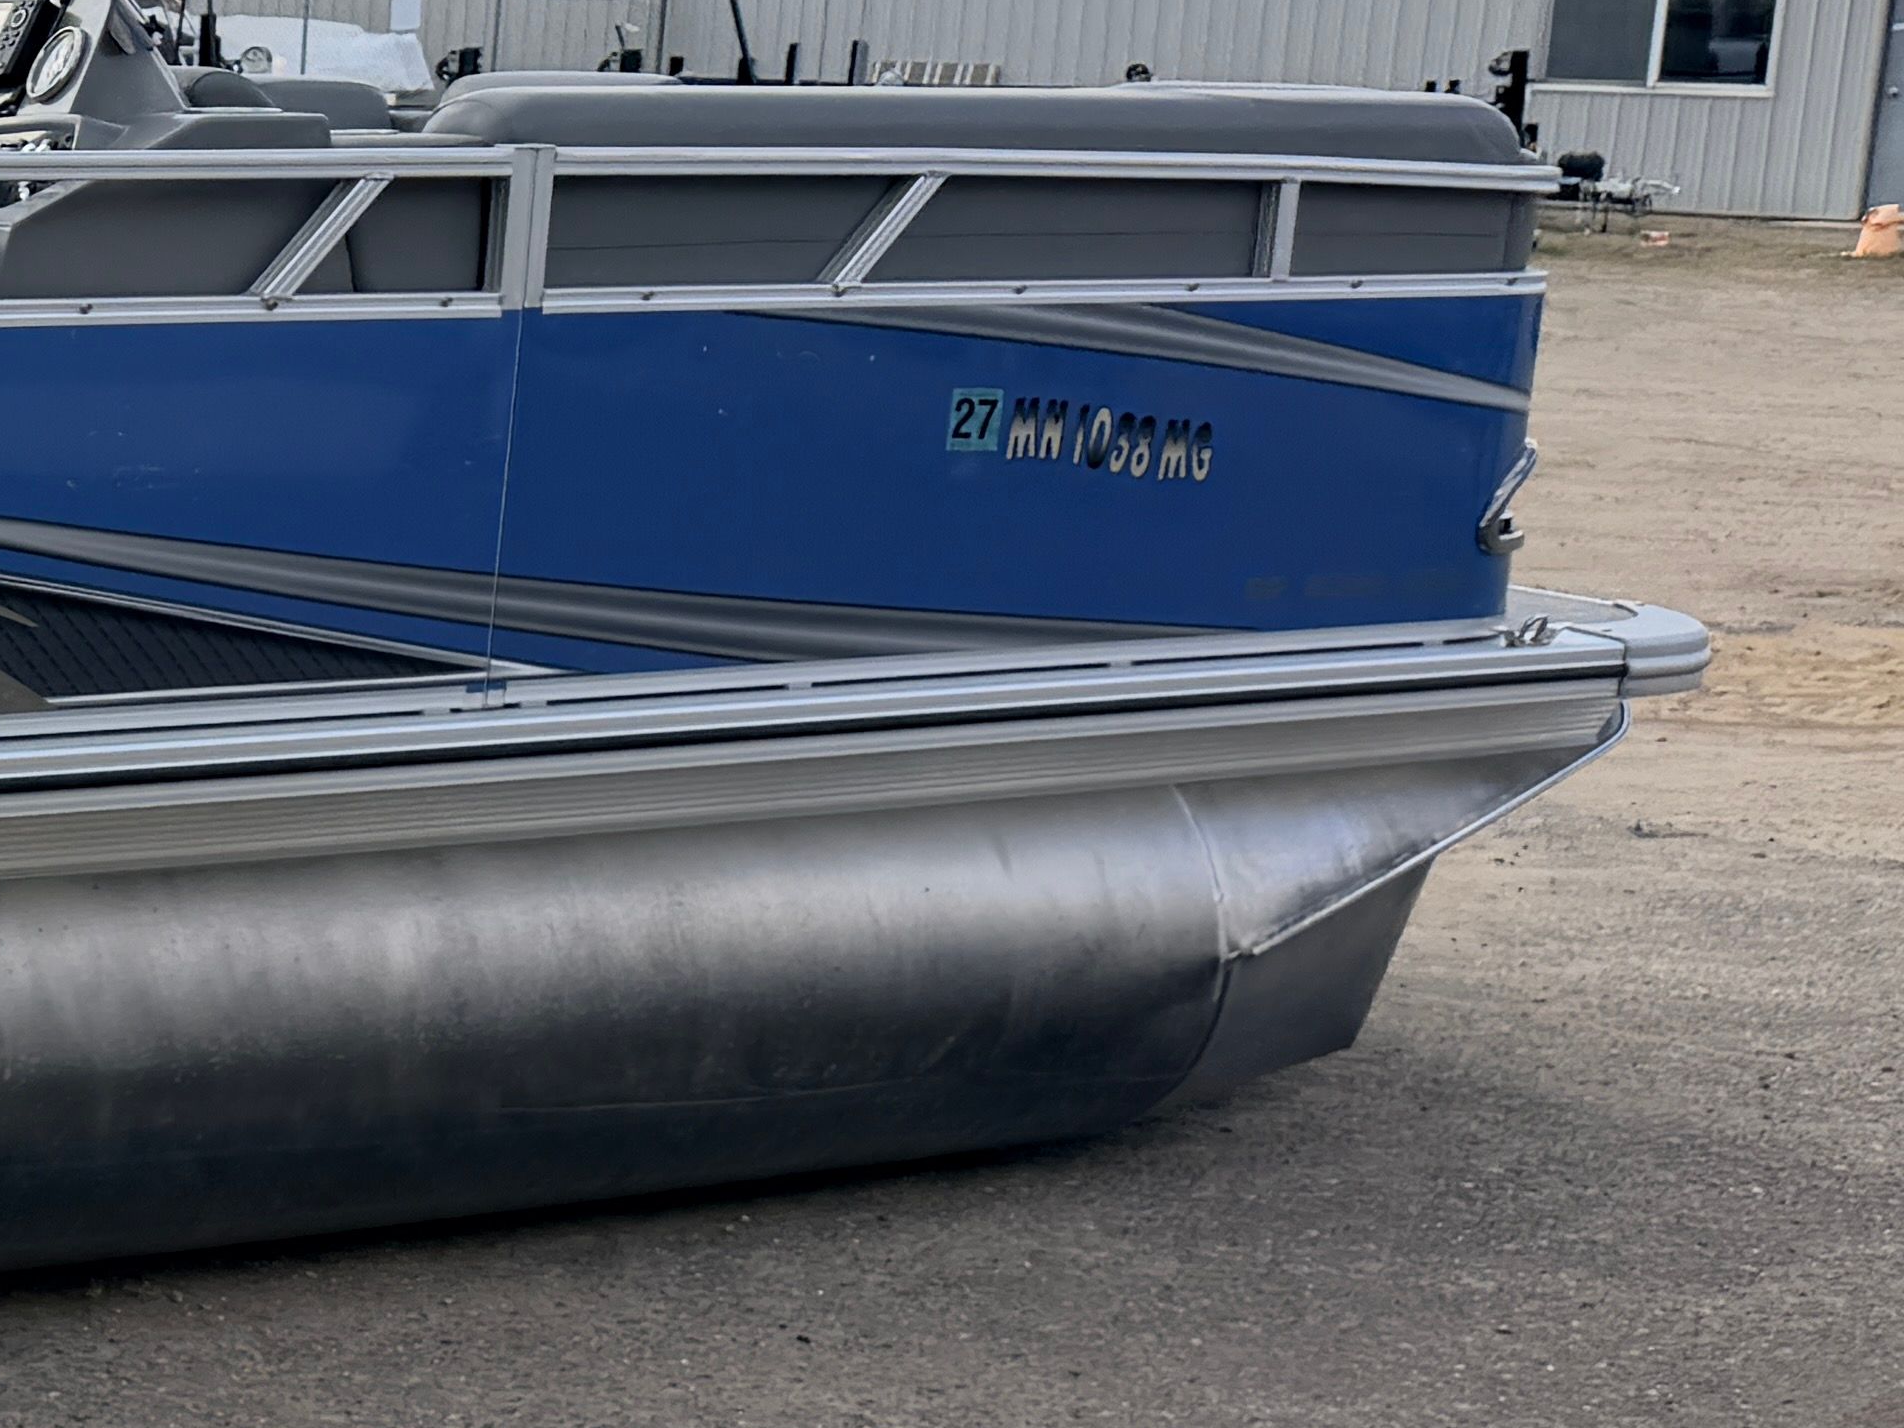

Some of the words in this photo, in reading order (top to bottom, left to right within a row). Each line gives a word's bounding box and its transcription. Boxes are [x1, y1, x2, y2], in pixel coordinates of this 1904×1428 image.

[951, 397, 999, 440] 27
[1005, 397, 1069, 460] MN
[1157, 418, 1213, 481] MG
